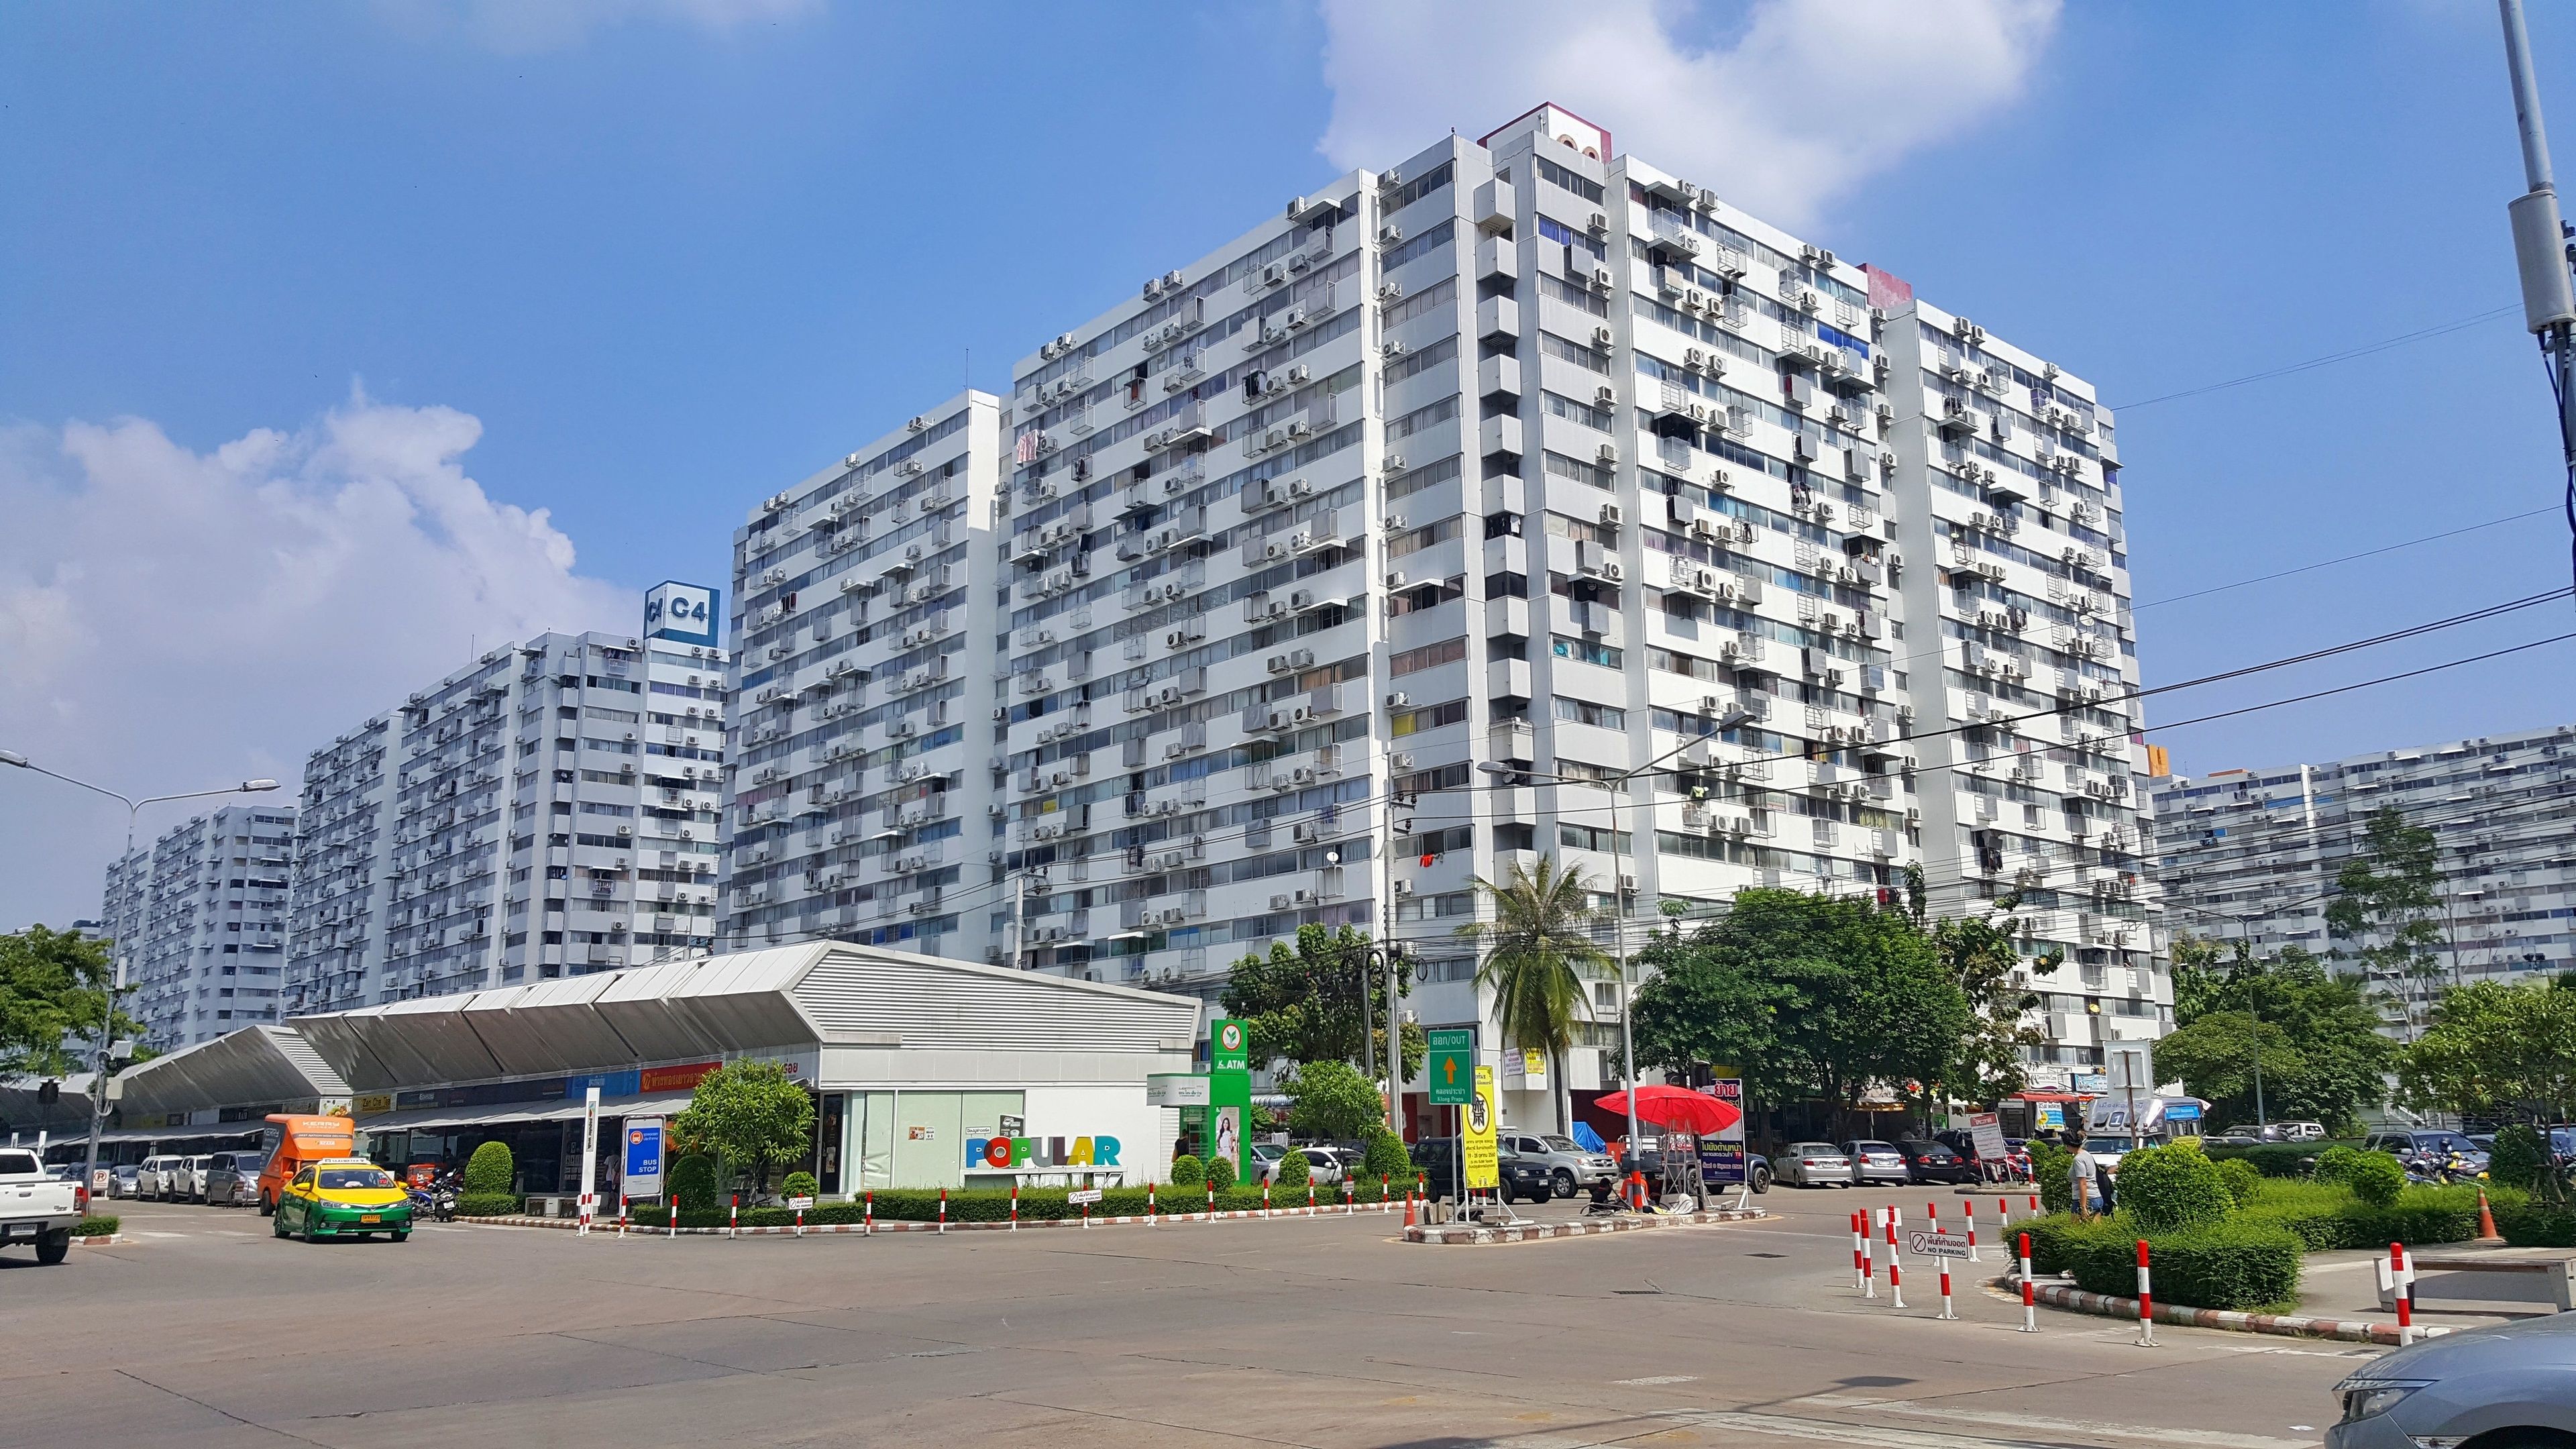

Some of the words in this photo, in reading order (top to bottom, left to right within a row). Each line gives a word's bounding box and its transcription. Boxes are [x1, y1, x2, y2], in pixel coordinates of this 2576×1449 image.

[647, 597, 663, 623] C4
[671, 597, 707, 621] C4
[1433, 1035, 1466, 1046] ออก/OUT
[1226, 1059, 1246, 1069] ATM
[1714, 1081, 1738, 1097] ย้าย
[966, 1136, 1121, 1169] POPULAR
[1927, 1235, 1966, 1248] พื้นที่ห้ามจอด
[1939, 1248, 1966, 1256] PARKING
